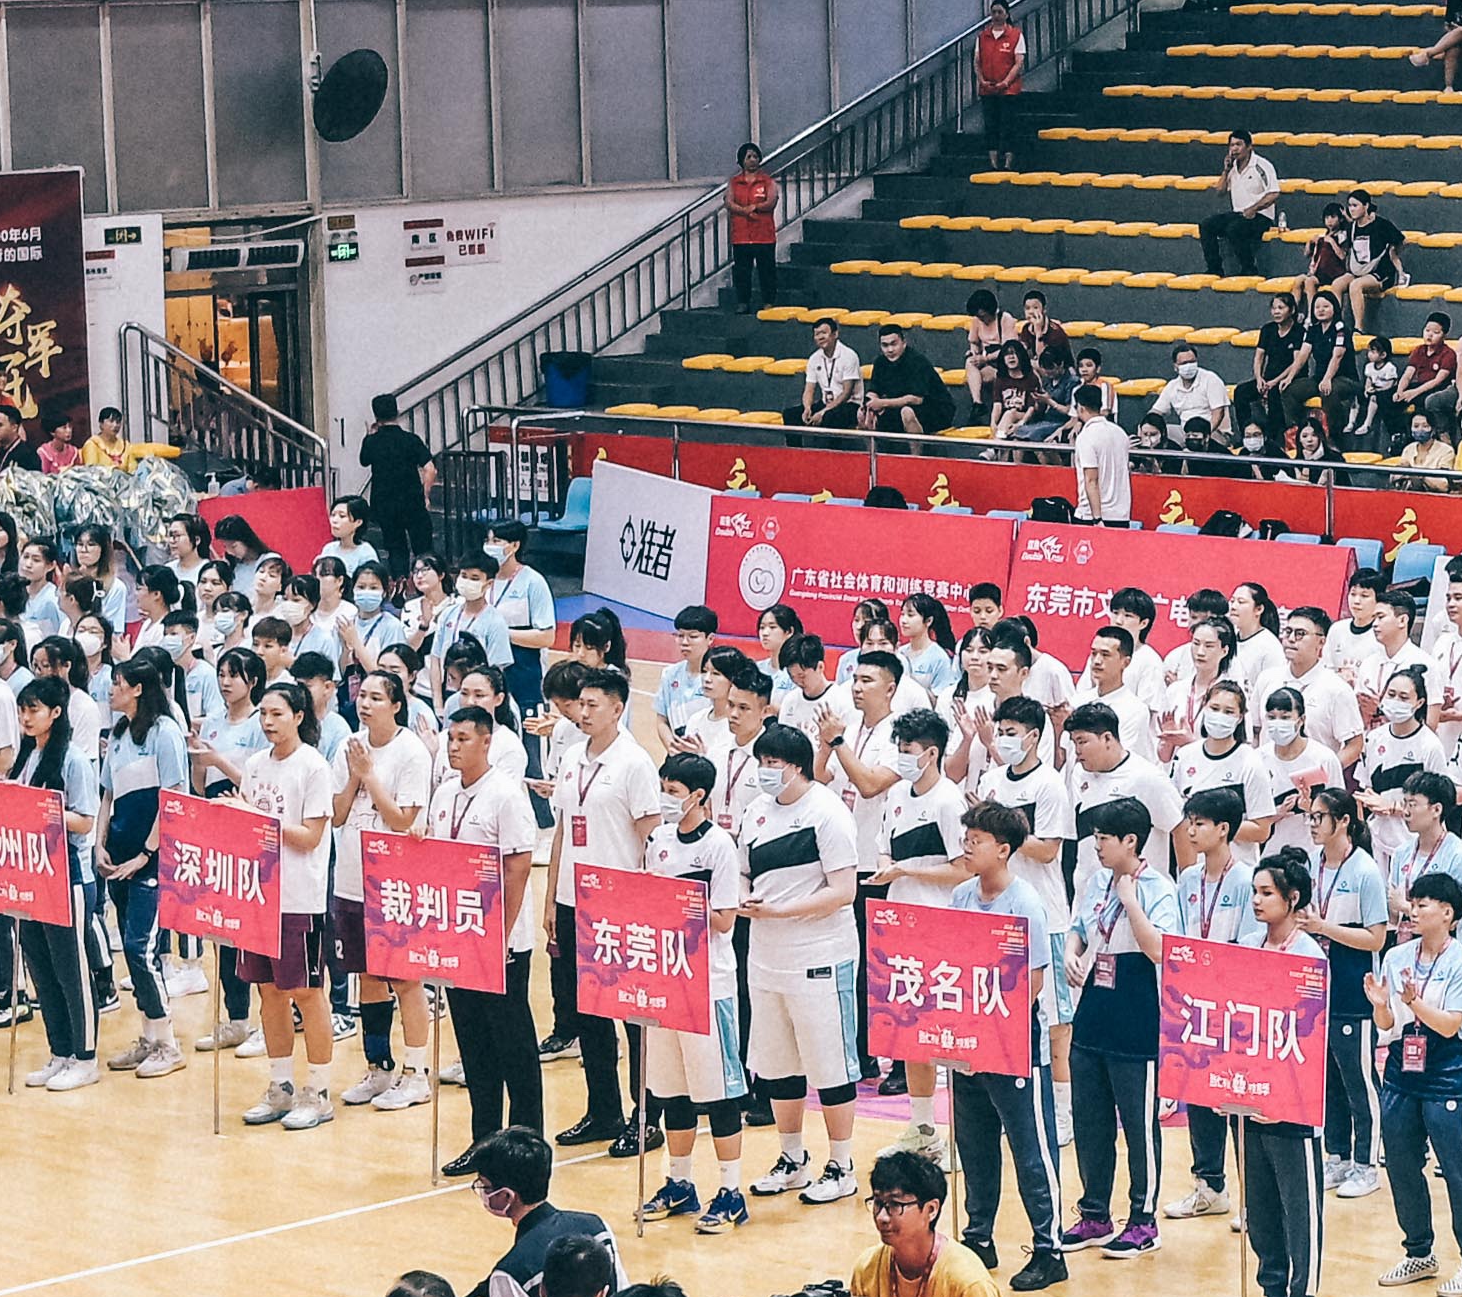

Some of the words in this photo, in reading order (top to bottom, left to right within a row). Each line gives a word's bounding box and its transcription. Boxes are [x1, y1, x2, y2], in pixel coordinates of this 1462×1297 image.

[173, 839, 266, 907] 深圳队
[380, 877, 487, 938] 裁判员
[591, 918, 695, 982] 东莞队
[886, 953, 1011, 1020] 茂名队
[1179, 993, 1307, 1066] 江门队
